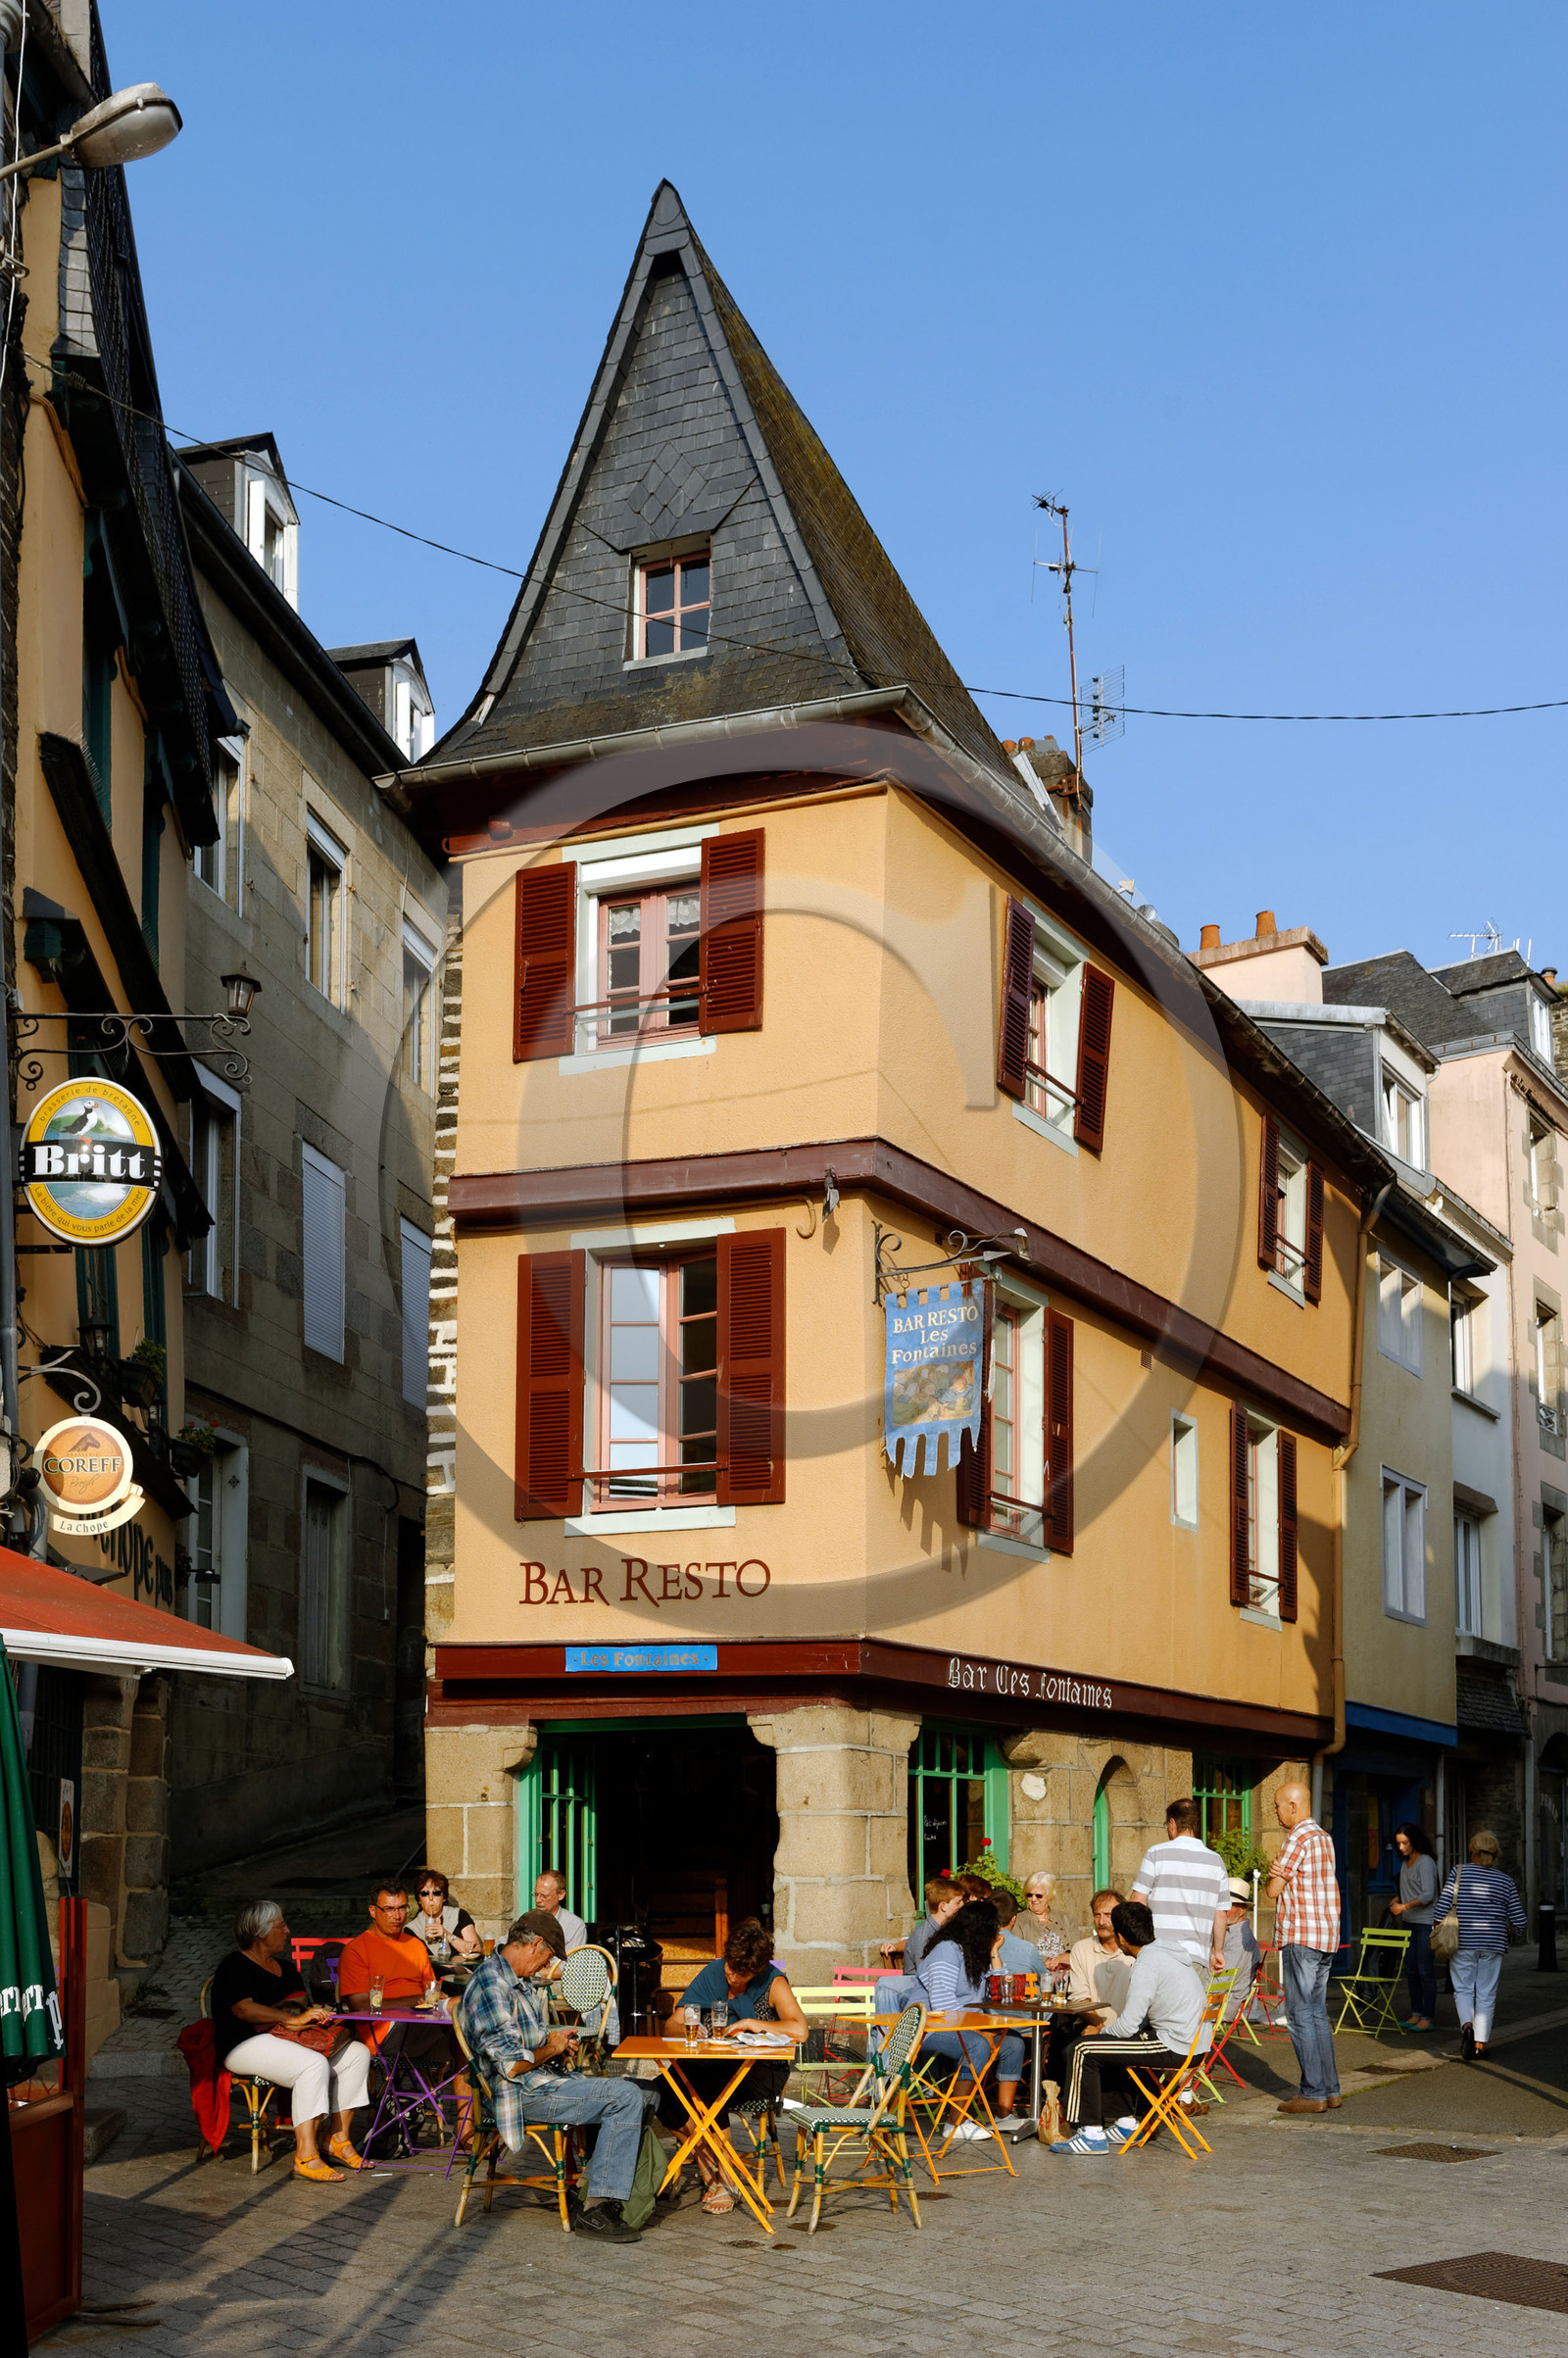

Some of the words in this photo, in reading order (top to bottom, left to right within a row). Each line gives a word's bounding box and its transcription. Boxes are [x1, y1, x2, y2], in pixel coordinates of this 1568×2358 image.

[39, 1088, 80, 1122] brasserie
[103, 1089, 141, 1126] bretagne
[32, 1144, 146, 1179] Britt
[34, 1186, 42, 1198] La
[40, 1198, 57, 1217] bière
[57, 1216, 71, 1227] qui
[72, 1223, 91, 1232] vous
[94, 1219, 115, 1233] parle
[116, 1213, 125, 1223] de
[124, 1205, 133, 1214] la
[132, 1190, 143, 1207] mer
[894, 1314, 925, 1334] BAR
[927, 1305, 978, 1324] RESTO
[920, 1328, 949, 1345] Les
[892, 1342, 977, 1364] Fontaines
[44, 1456, 122, 1474] COREFF
[60, 1520, 73, 1531] La
[75, 1521, 109, 1533] Chope
[581, 1650, 609, 1666] Les
[613, 1650, 699, 1666] Fontaines
[948, 1656, 988, 1691] Bar
